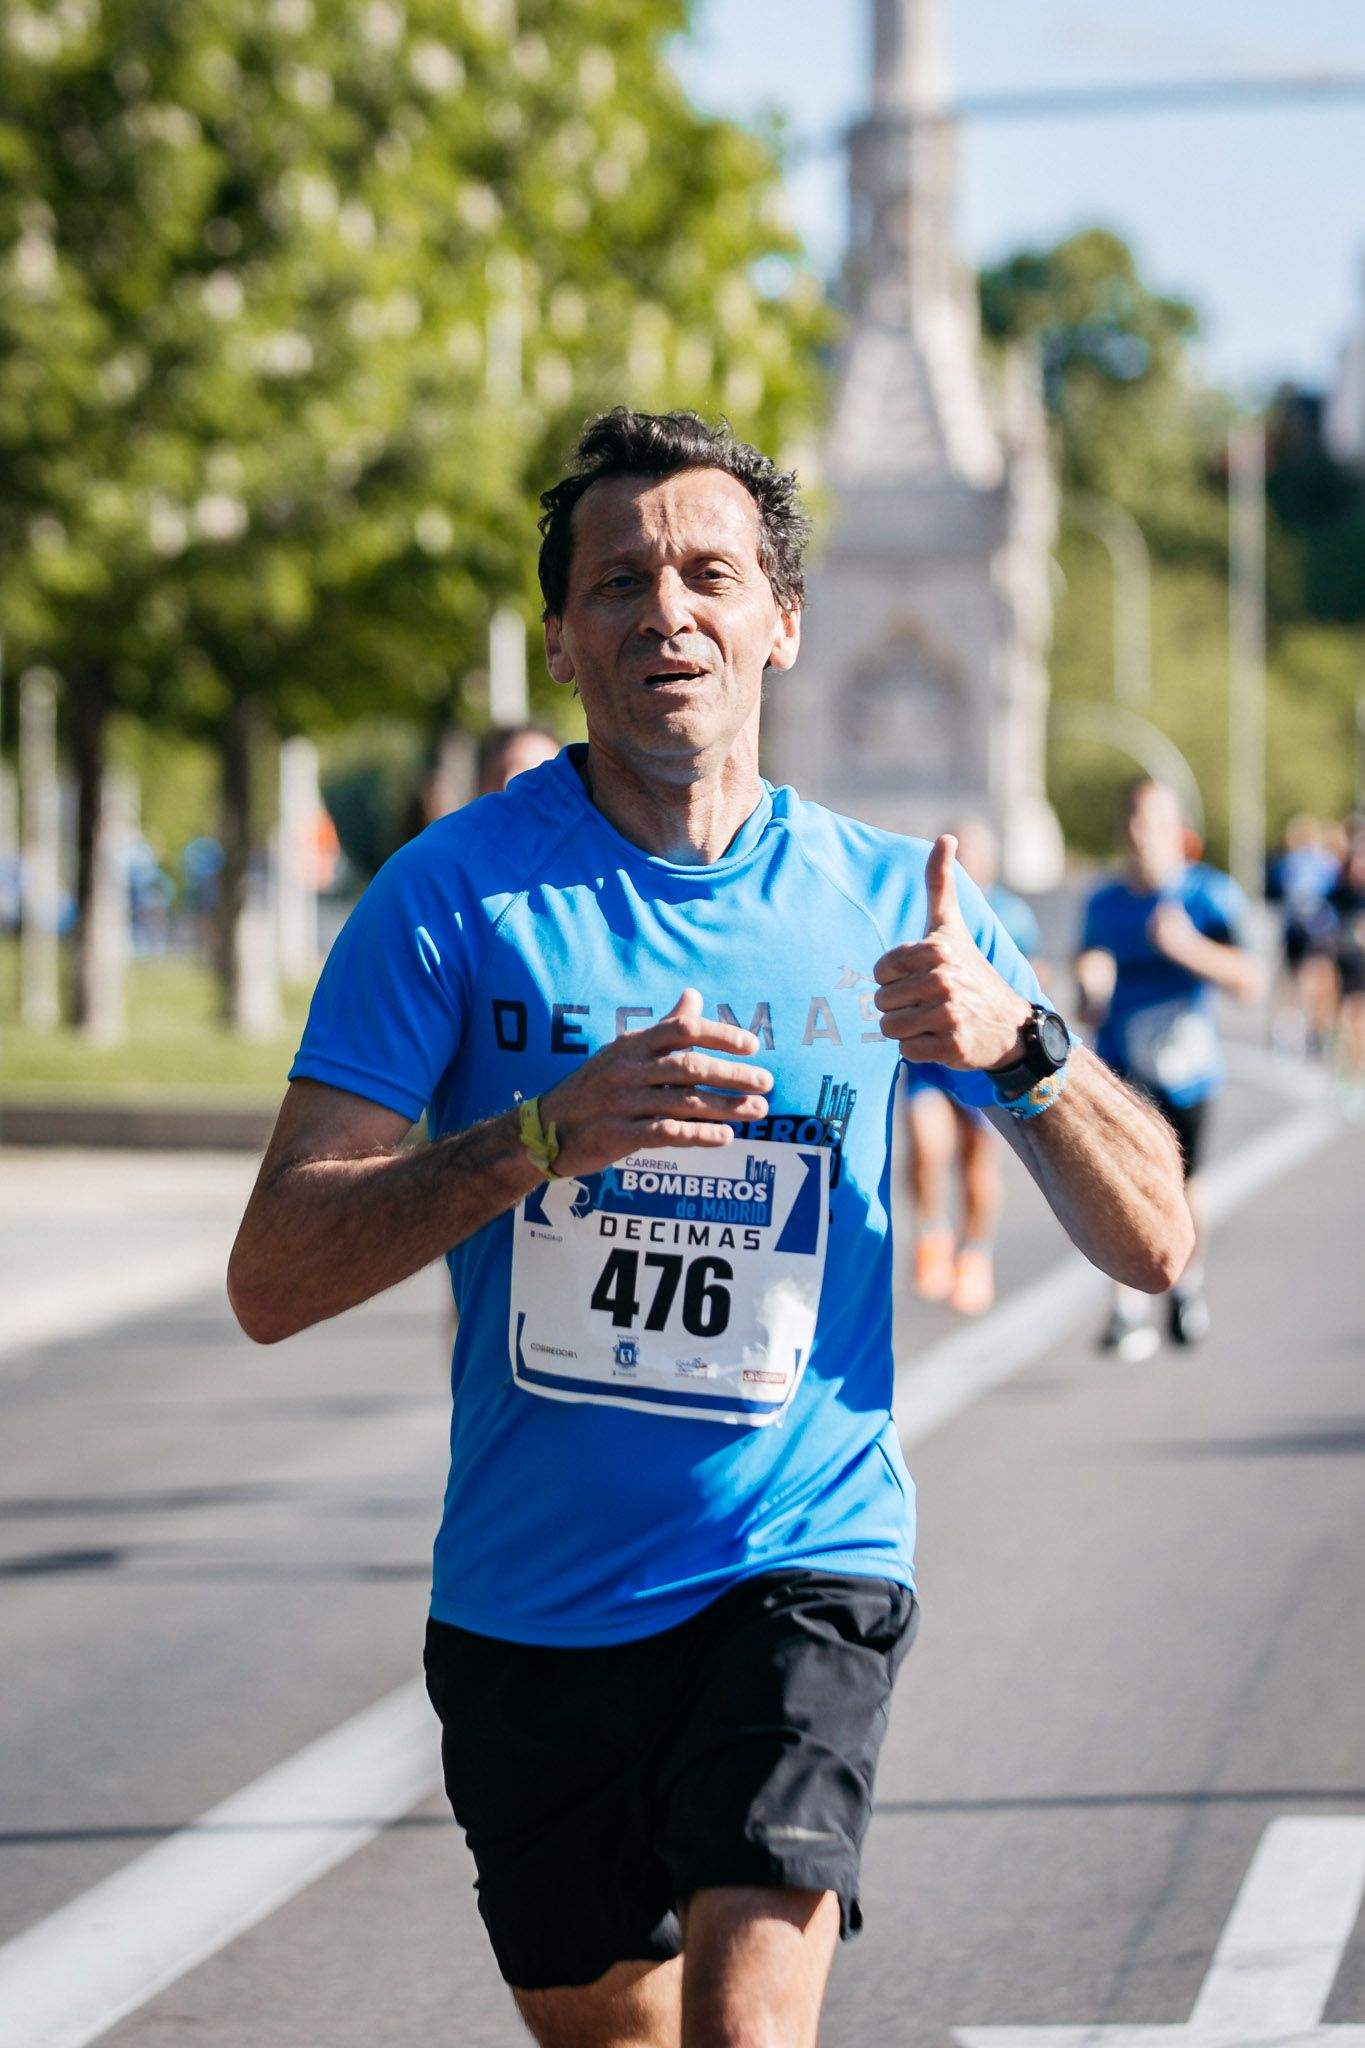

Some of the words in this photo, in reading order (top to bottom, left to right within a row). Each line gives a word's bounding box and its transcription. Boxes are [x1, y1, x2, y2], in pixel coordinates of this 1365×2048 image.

[491, 993, 888, 1054] DECMAS
[625, 1157, 679, 1171] CARRERA
[622, 1170, 768, 1203] BOMBEROS
[675, 1197, 696, 1219] de
[702, 1199, 767, 1224] MADRID
[600, 1215, 760, 1251] DECIMAS
[591, 1247, 734, 1338] 476
